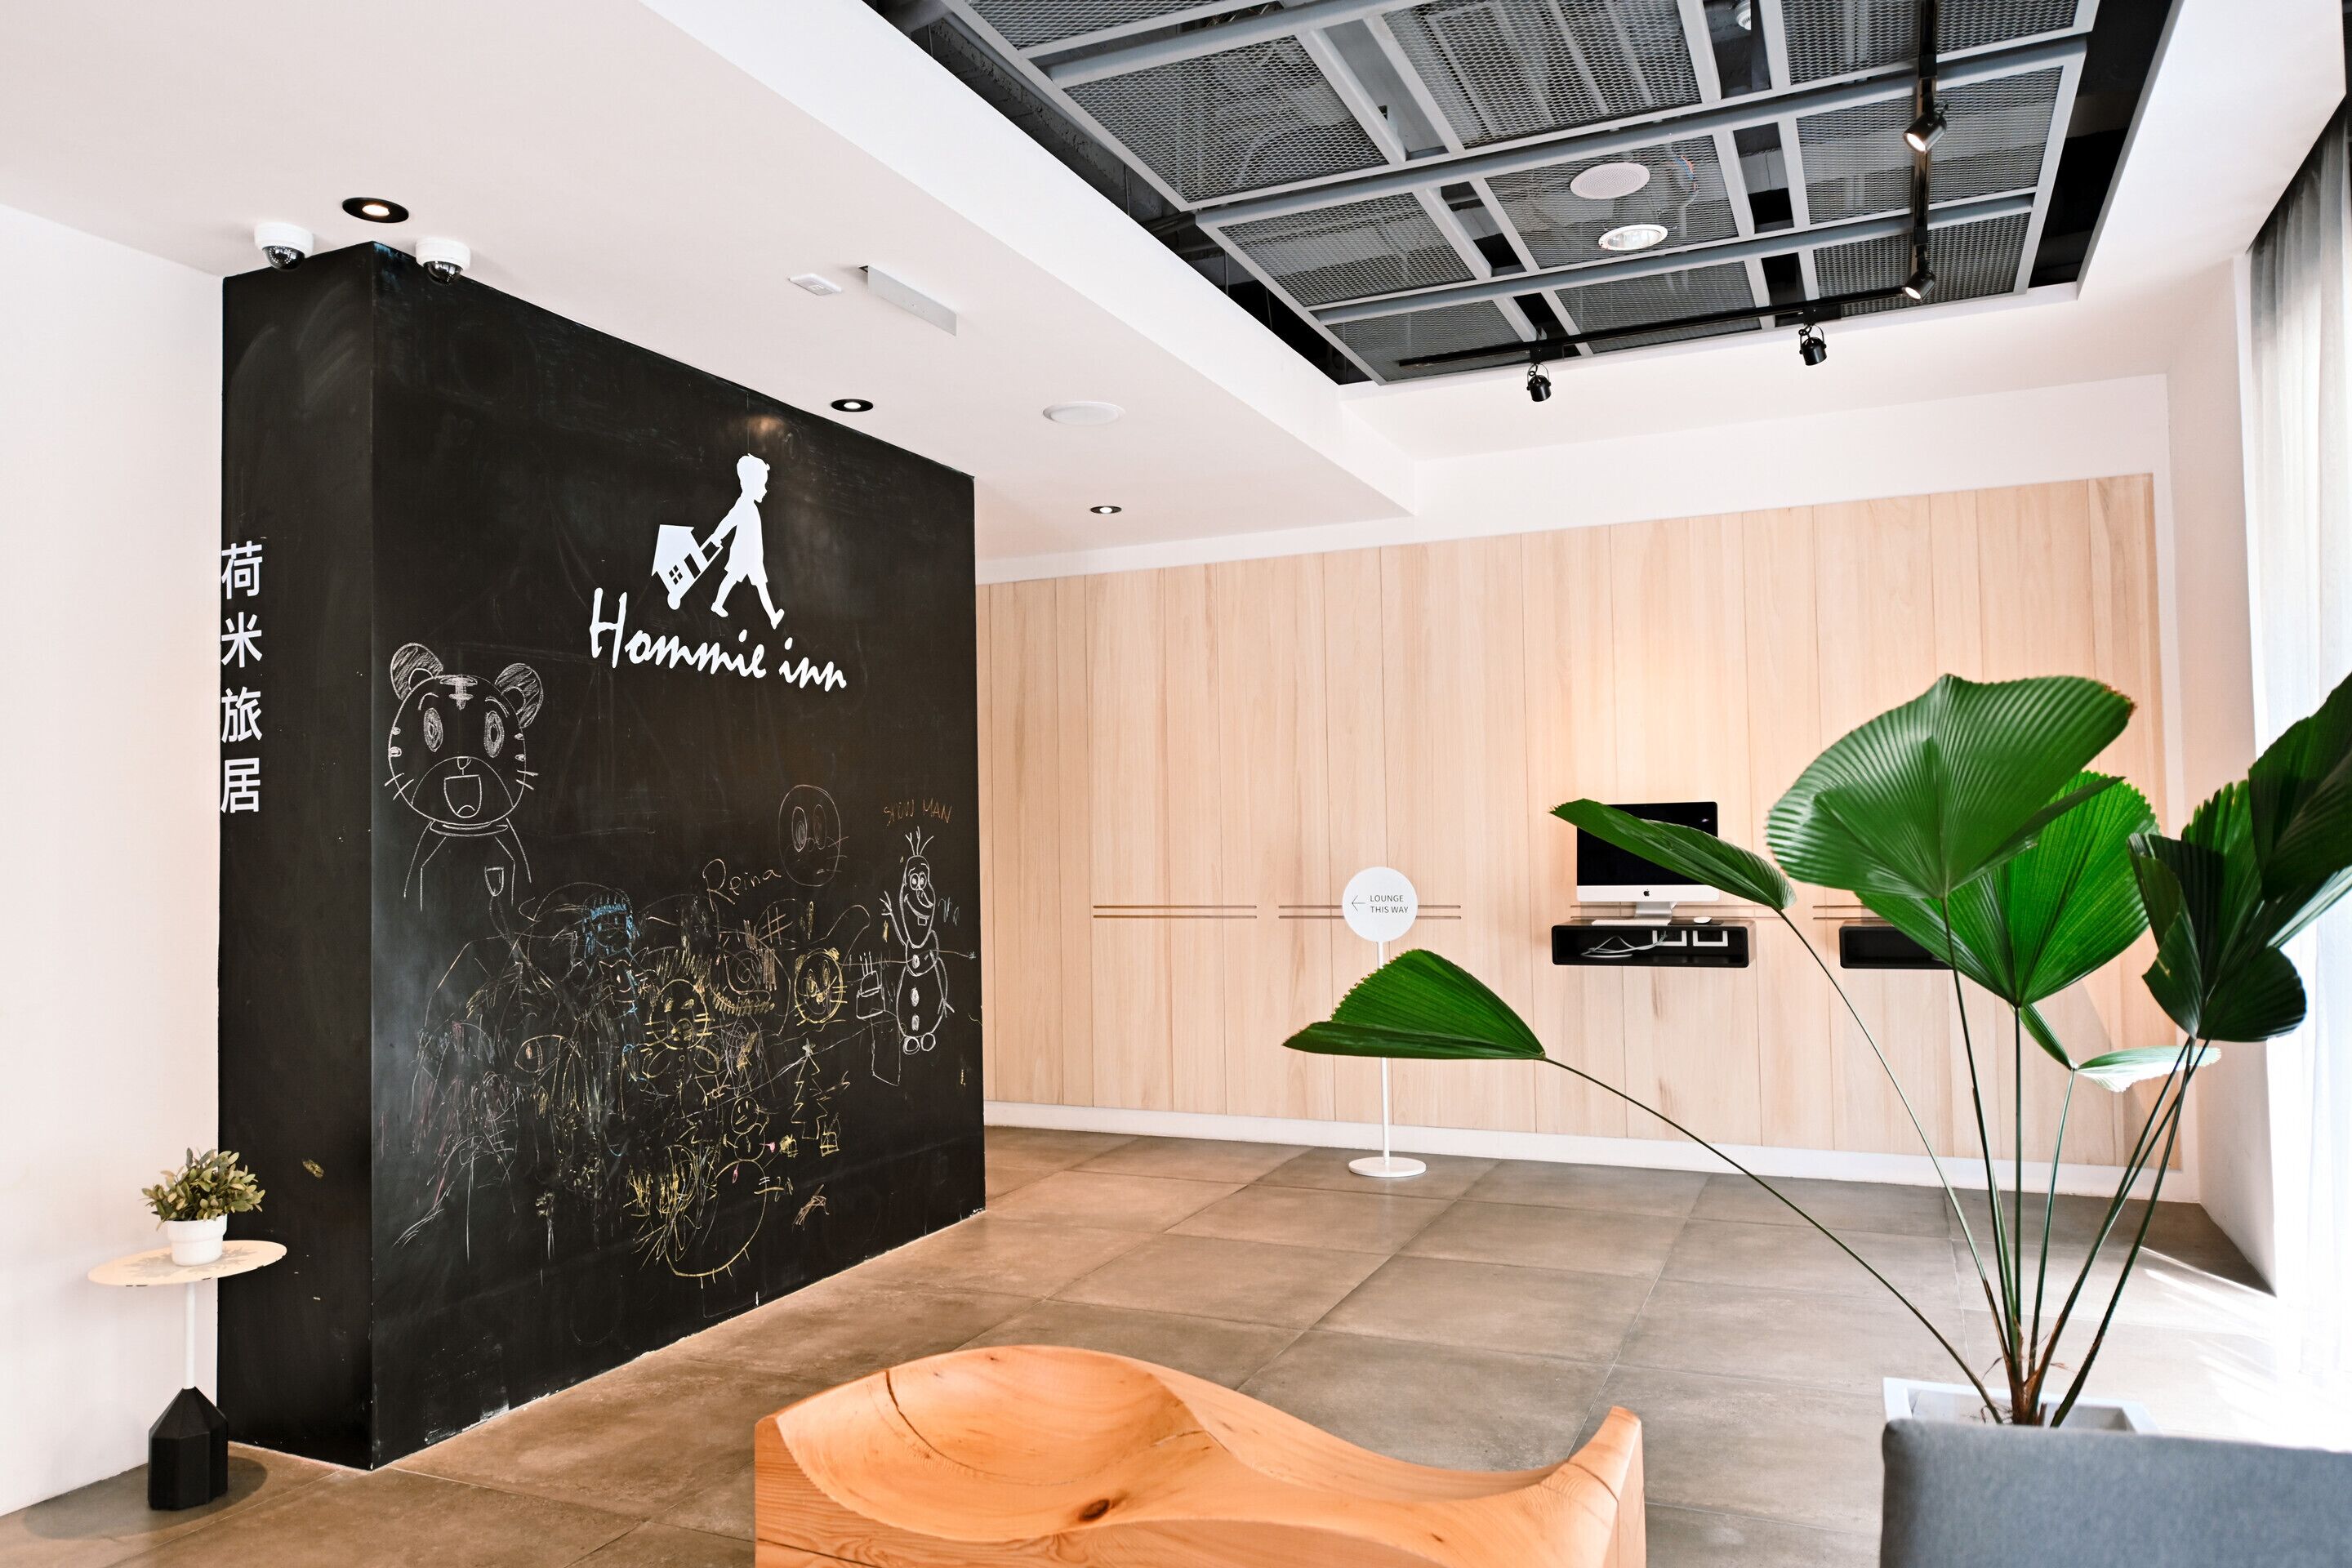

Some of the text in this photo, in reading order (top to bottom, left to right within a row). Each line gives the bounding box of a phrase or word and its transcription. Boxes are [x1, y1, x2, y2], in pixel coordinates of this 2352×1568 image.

[589, 587, 847, 692] Hommie inn
[220, 540, 263, 814] 荷米旅居
[702, 858, 782, 911] Reina
[1370, 894, 1405, 902] LOUNGE
[1370, 906, 1409, 914] THIS WAY
